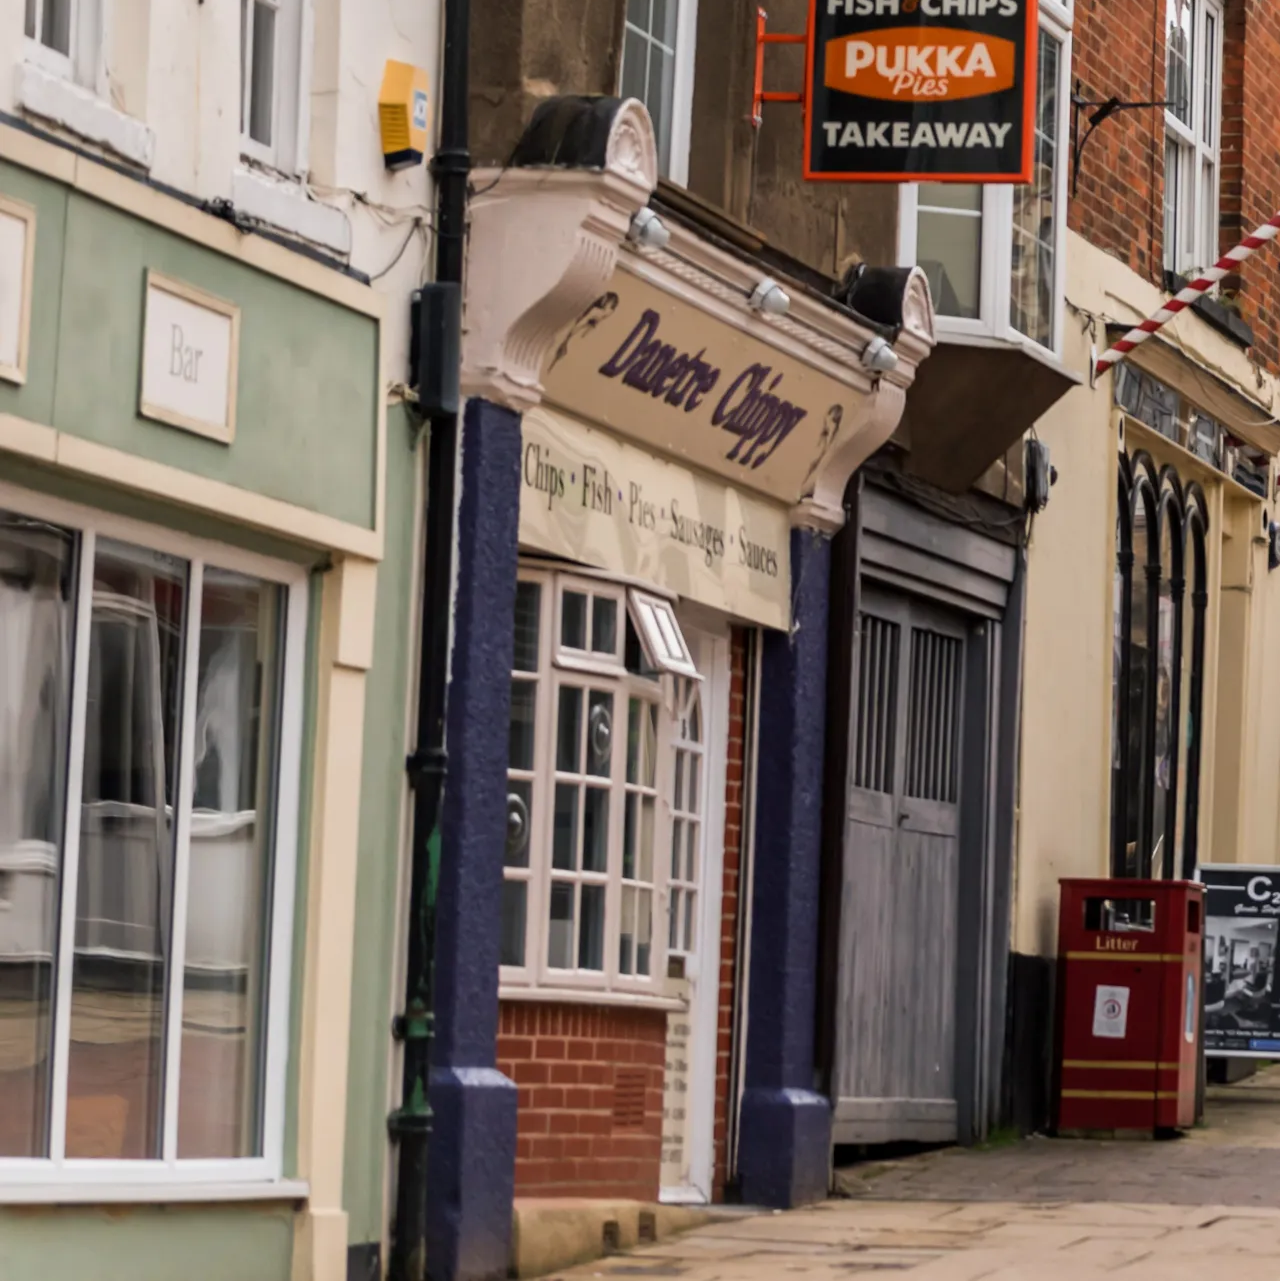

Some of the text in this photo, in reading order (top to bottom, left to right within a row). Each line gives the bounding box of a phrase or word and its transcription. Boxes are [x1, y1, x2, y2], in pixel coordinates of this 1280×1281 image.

[844, 40, 997, 79] PUKKA
[892, 69, 950, 96] Pies
[822, 121, 1012, 149] TAKEAWAY
[169, 323, 203, 383] Bar
[598, 308, 808, 470] Danetre Chippy
[524, 442, 778, 578] Chips Fish Pies Sausages Sauces
[1096, 935, 1139, 951] Litter
